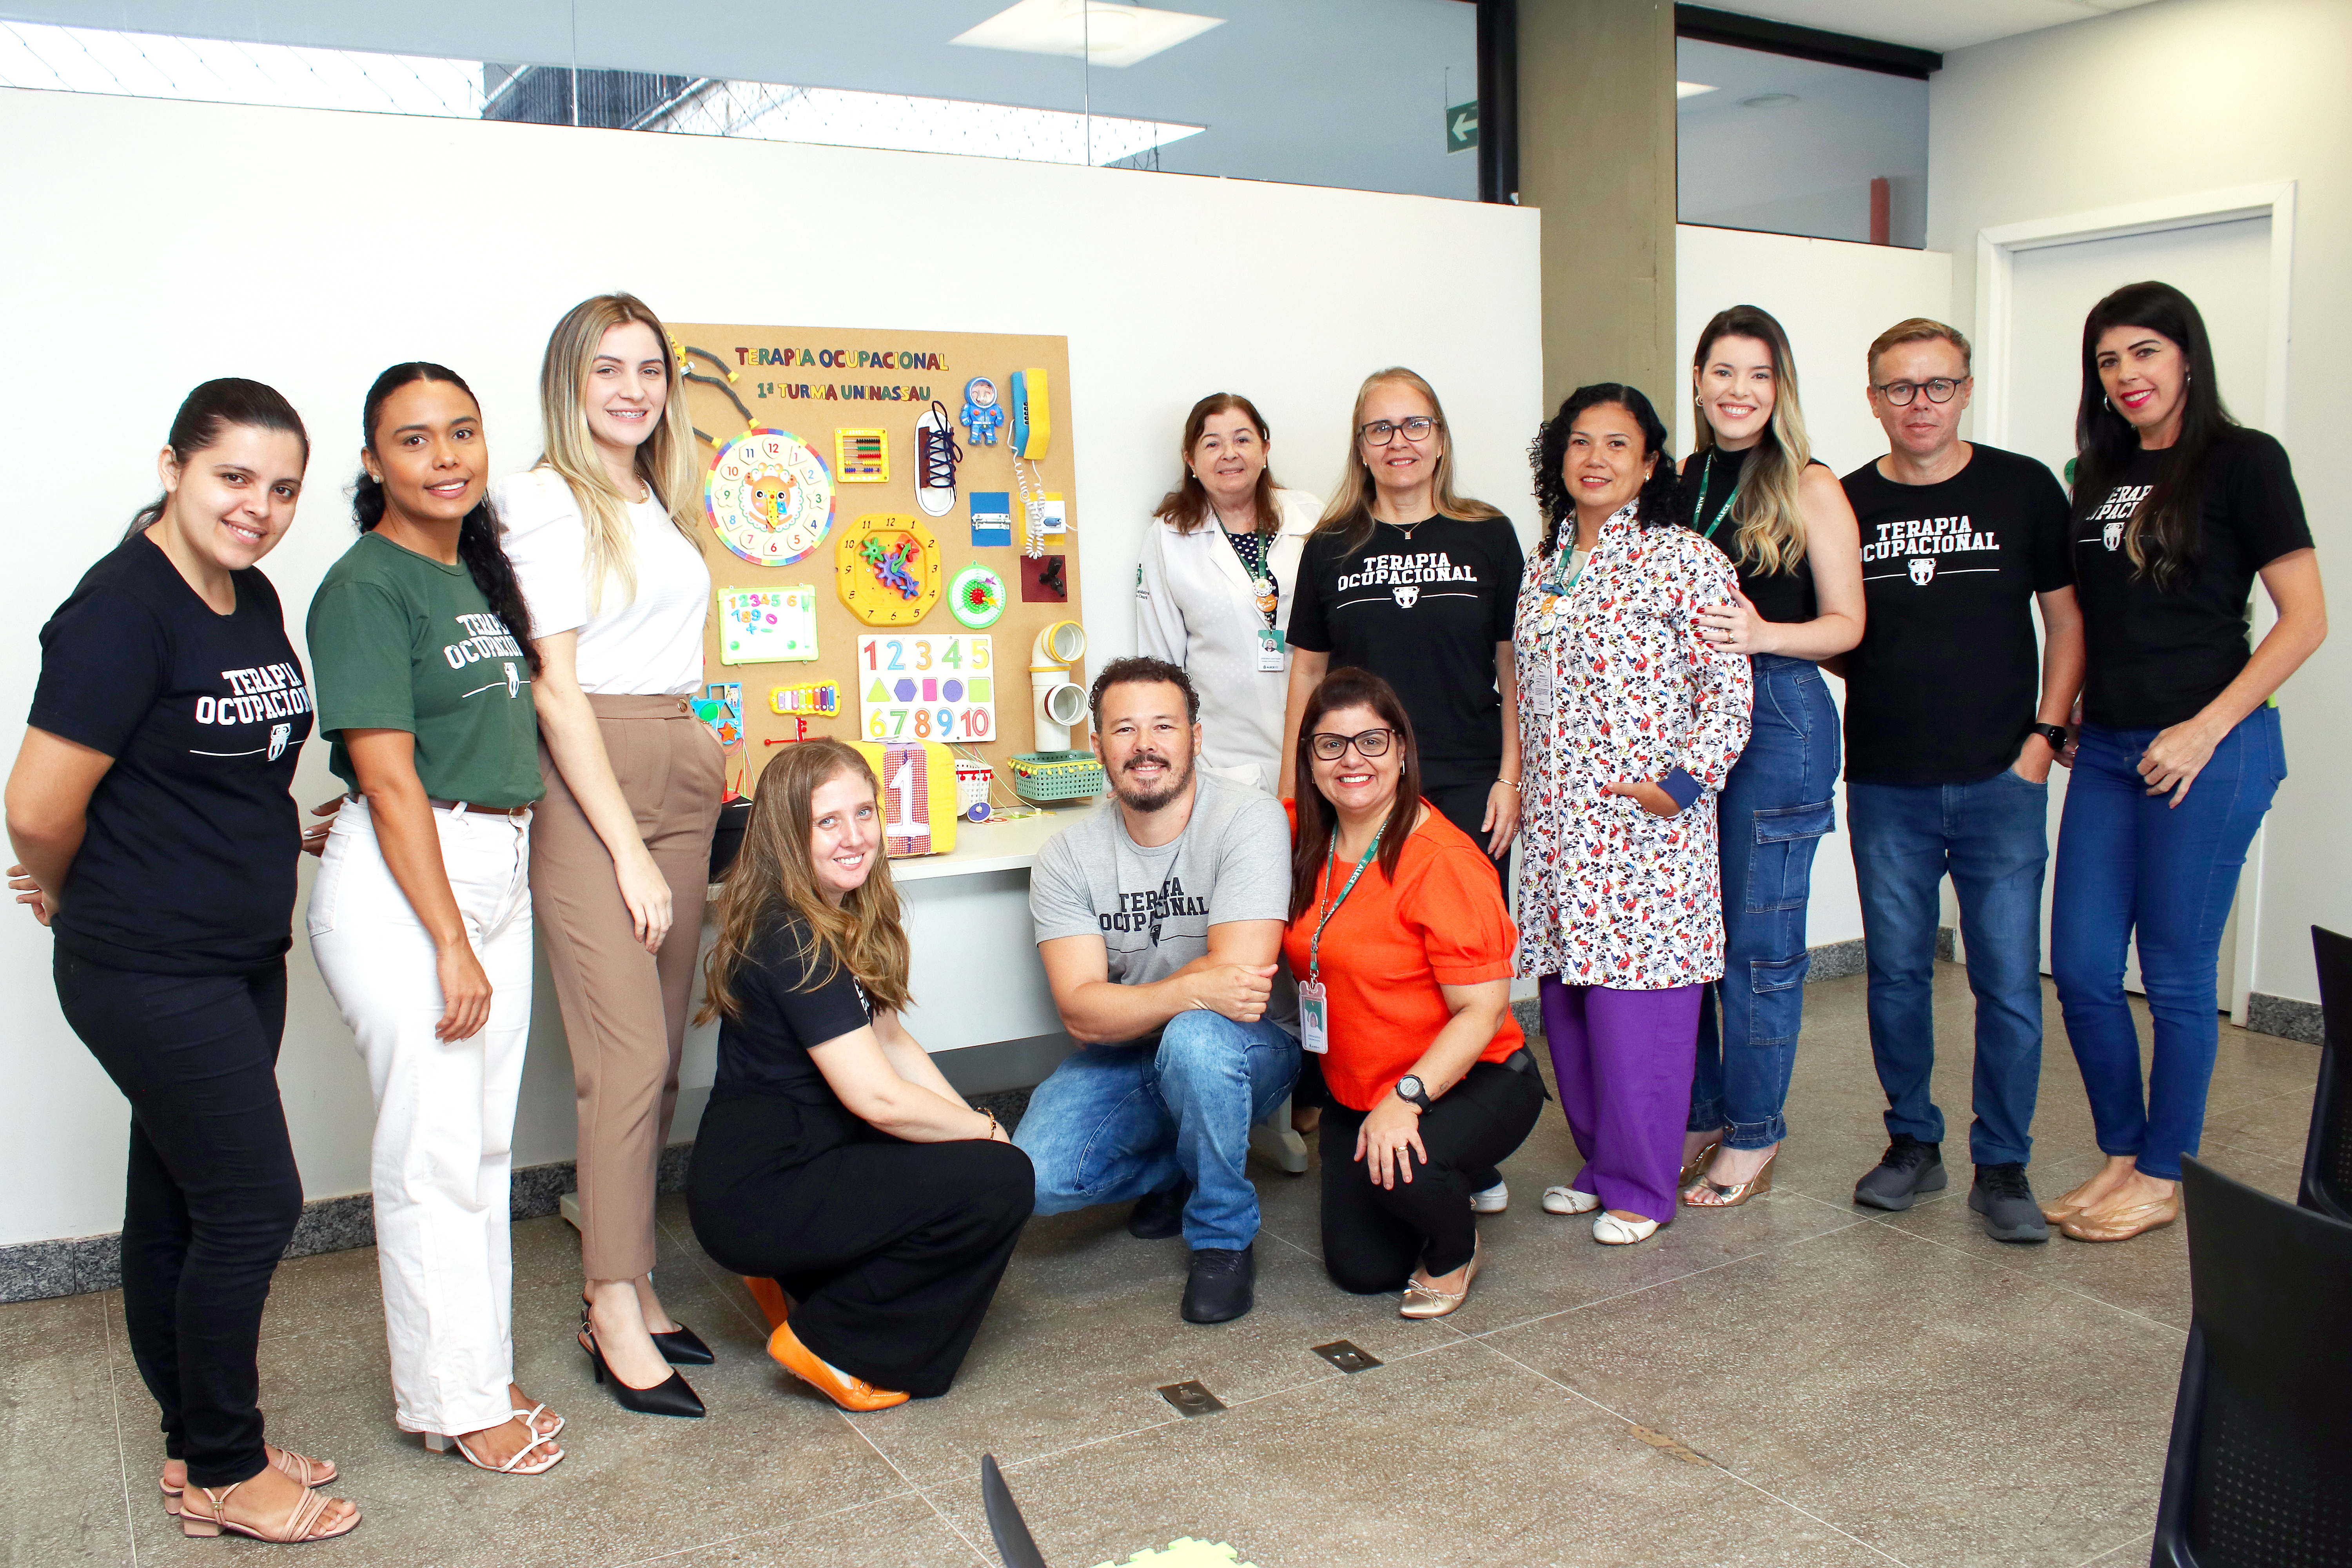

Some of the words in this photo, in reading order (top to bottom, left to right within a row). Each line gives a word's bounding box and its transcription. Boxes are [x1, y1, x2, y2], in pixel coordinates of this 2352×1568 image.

[735, 347, 815, 367] TERAPIA
[819, 349, 949, 371] OCUPACIONAL
[778, 383, 838, 401] TURMA
[841, 385, 931, 401] UNINASSAU
[746, 448, 754, 458] 11
[768, 443, 779, 453] 12
[794, 453, 797, 462] 1
[727, 466, 739, 476] 10
[808, 470, 814, 479] 2
[724, 490, 730, 499] 9
[816, 494, 822, 503] 3
[1695, 496, 1704, 514] ALECE
[1717, 504, 1731, 522] ALECE
[730, 515, 736, 524] 8
[811, 520, 817, 529] 4
[862, 521, 870, 529] 11
[911, 521, 915, 529] 1
[1877, 515, 1972, 541] TERAPIA
[747, 535, 753, 544] 7
[795, 535, 800, 544] 5
[845, 540, 855, 548] 10
[771, 543, 777, 552] 6
[1860, 532, 2000, 562] CUPACIONAL
[1363, 552, 1451, 572] TERAPIA
[845, 566, 852, 574] 9
[1555, 566, 1564, 584] ALECE
[1338, 565, 1477, 592] OCUPACIONAL
[849, 591, 855, 599] 8
[787, 595, 797, 606] 6
[891, 612, 897, 620] 6
[913, 609, 920, 617] 5
[766, 613, 777, 624] 0
[864, 641, 877, 670] 1
[886, 641, 905, 670] 2
[915, 641, 932, 670] 3
[942, 641, 962, 669] 4
[971, 639, 989, 670] 5
[221, 662, 302, 696] TERAPIA
[869, 710, 886, 737] 6
[890, 711, 908, 738] 7
[915, 710, 931, 738] 8
[937, 709, 953, 737] 9
[961, 709, 989, 737] 10
[885, 759, 930, 838] 1
[1348, 863, 1364, 884] ALECE
